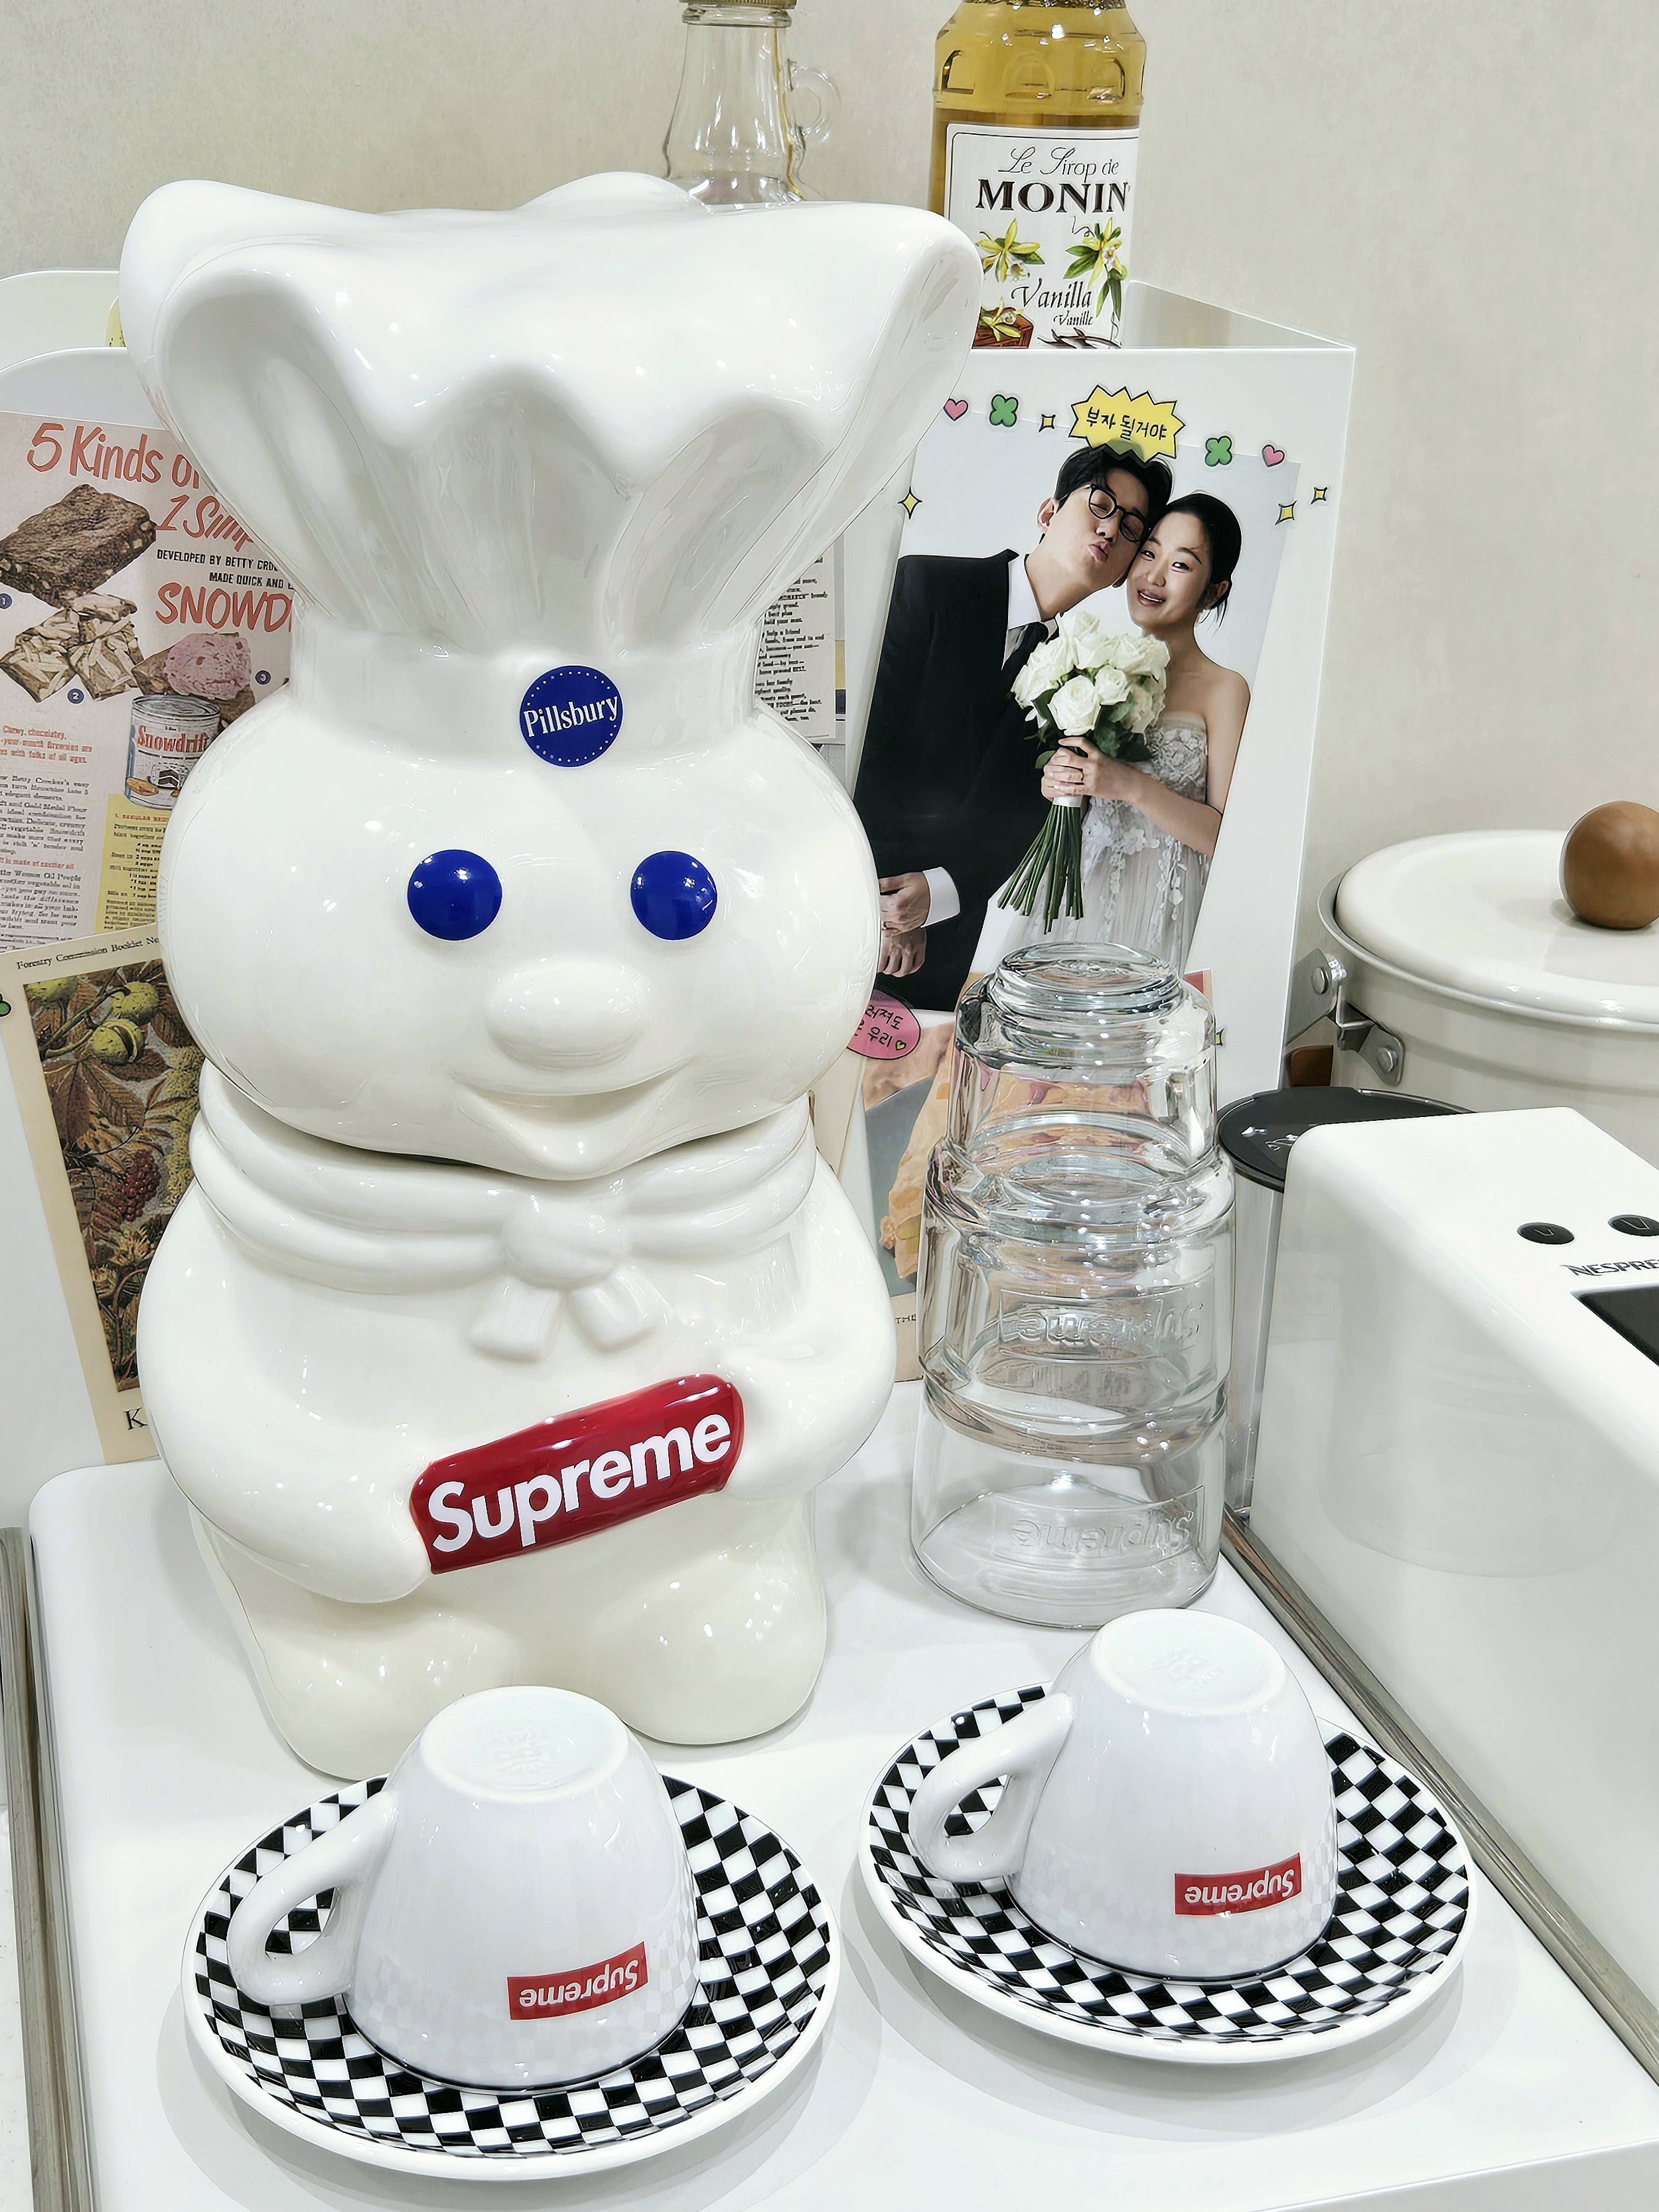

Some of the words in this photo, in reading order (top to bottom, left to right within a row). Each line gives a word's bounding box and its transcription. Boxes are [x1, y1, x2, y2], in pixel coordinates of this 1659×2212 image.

[997, 146, 1036, 174] Le
[1040, 147, 1097, 183] Sirop
[1102, 159, 1119, 175] de
[975, 178, 1129, 214] MONIN
[1011, 277, 1092, 309] Vanilla
[1052, 310, 1094, 327] Vanille
[1086, 406, 1116, 430] 부자
[1119, 414, 1167, 441] 될거야
[26, 422, 65, 473] 5
[68, 425, 165, 483] Kinds
[157, 548, 206, 564] DEVELOPED
[209, 555, 222, 565] BY
[225, 556, 253, 569] BETTY
[209, 572, 234, 584] MADE
[236, 574, 263, 587] QUICK
[265, 577, 284, 589] AND
[523, 696, 618, 737] Pillsbury
[867, 1026, 893, 1048] 우리
[1559, 1259, 1659, 1276] NESPRE
[428, 1413, 731, 1553] Supreme
[1184, 1868, 1295, 1904] Supreme
[519, 1958, 639, 2008] Supreme
